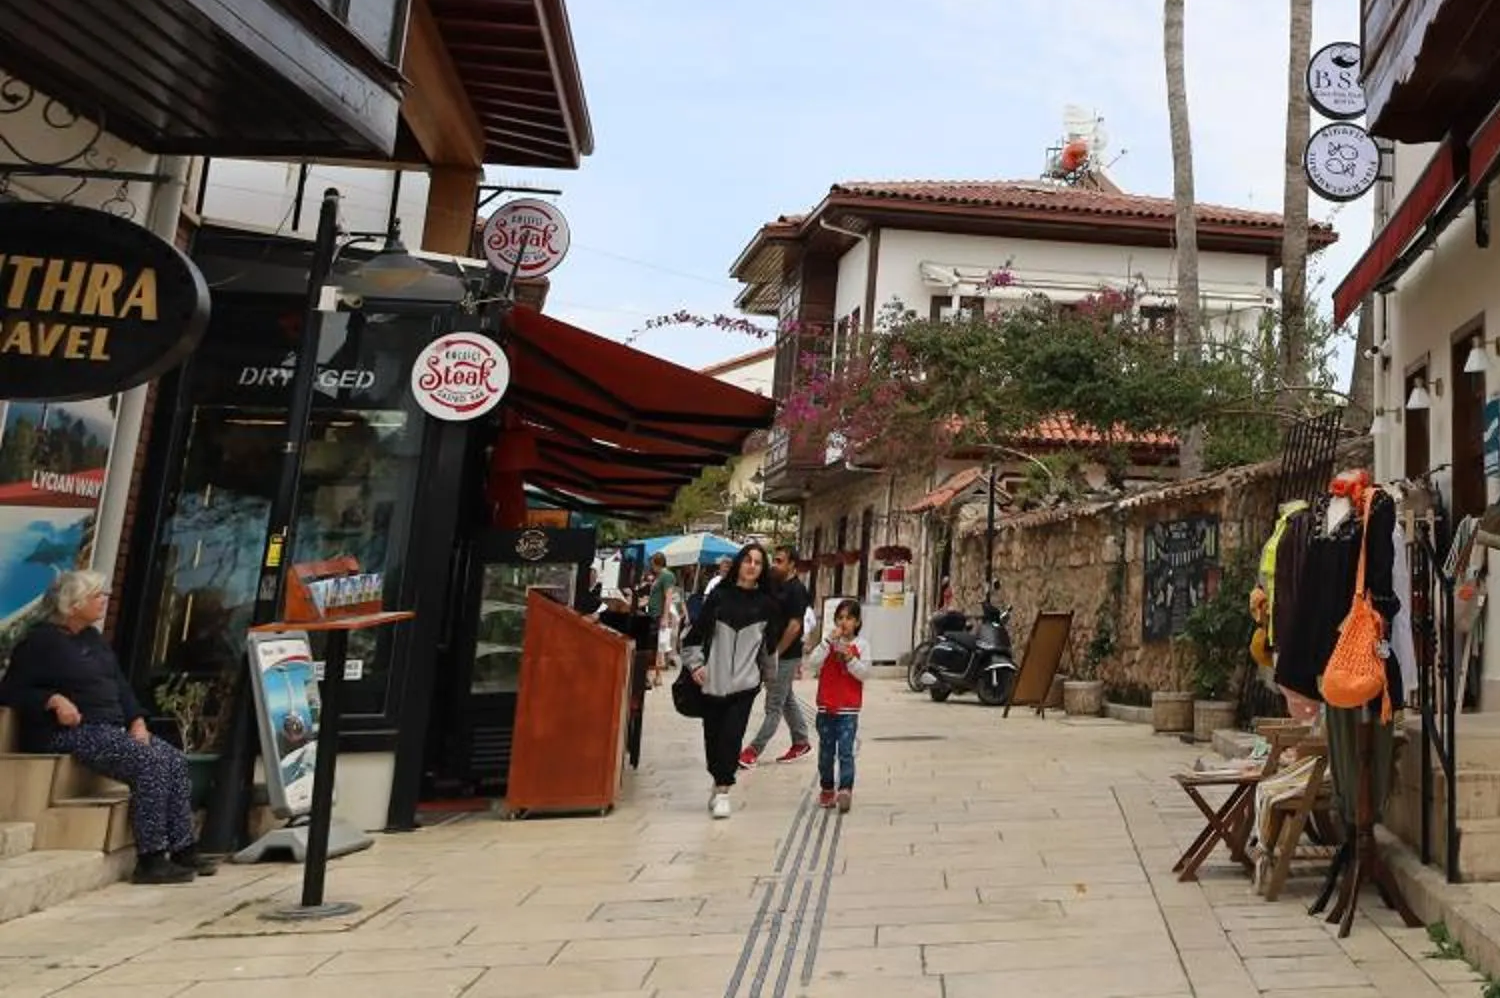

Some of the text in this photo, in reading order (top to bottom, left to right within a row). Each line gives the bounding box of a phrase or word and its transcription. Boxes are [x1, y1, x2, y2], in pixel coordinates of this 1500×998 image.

[0, 254, 158, 321] THRA
[0, 320, 111, 361] AVEL
[239, 366, 375, 389] DRY GED
[419, 355, 499, 394] Steak
[32, 469, 75, 494] LYCIAN
